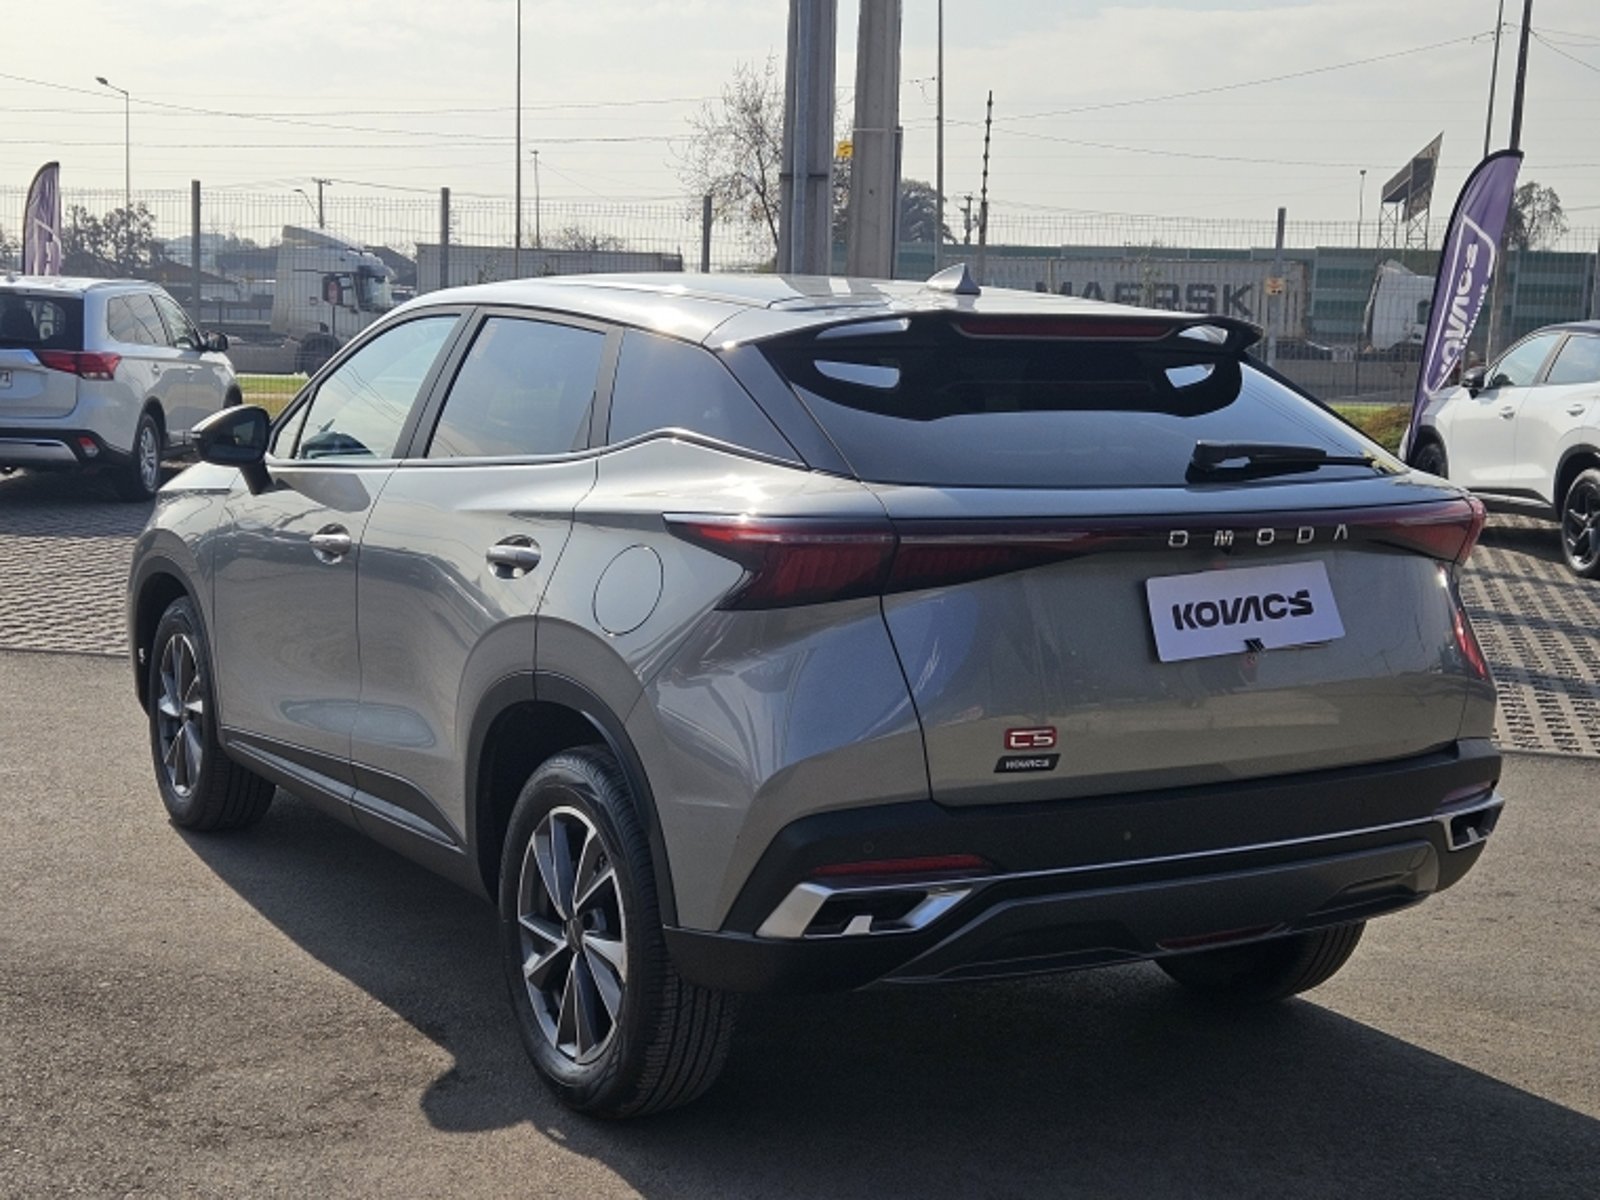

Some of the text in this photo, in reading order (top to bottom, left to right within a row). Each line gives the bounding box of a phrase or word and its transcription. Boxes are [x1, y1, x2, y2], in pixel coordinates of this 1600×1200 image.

[1168, 524, 1348, 547] OMODA
[1172, 590, 1314, 630] KOVACS
[1010, 730, 1053, 747] C5
